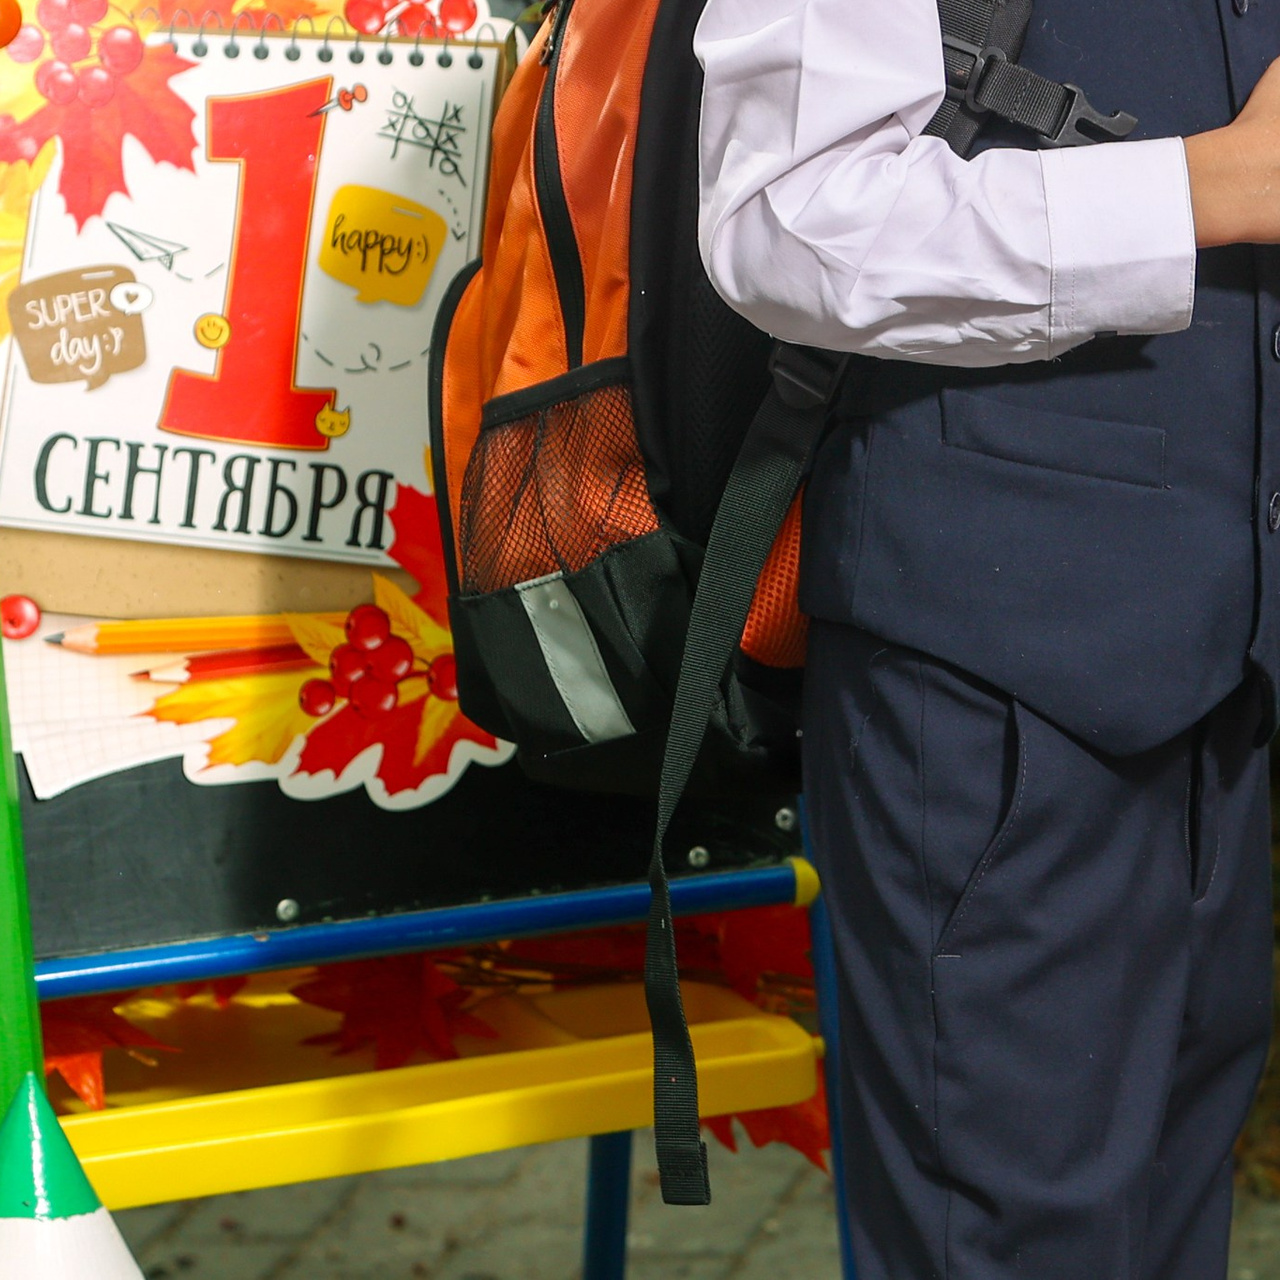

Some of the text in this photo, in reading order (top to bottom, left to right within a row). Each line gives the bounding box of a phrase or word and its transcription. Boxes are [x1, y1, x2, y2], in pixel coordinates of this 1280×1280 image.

[25, 288, 112, 330] SUPER
[157, 74, 336, 451] 1
[34, 432, 394, 550] СЕНТЯБРЯ
